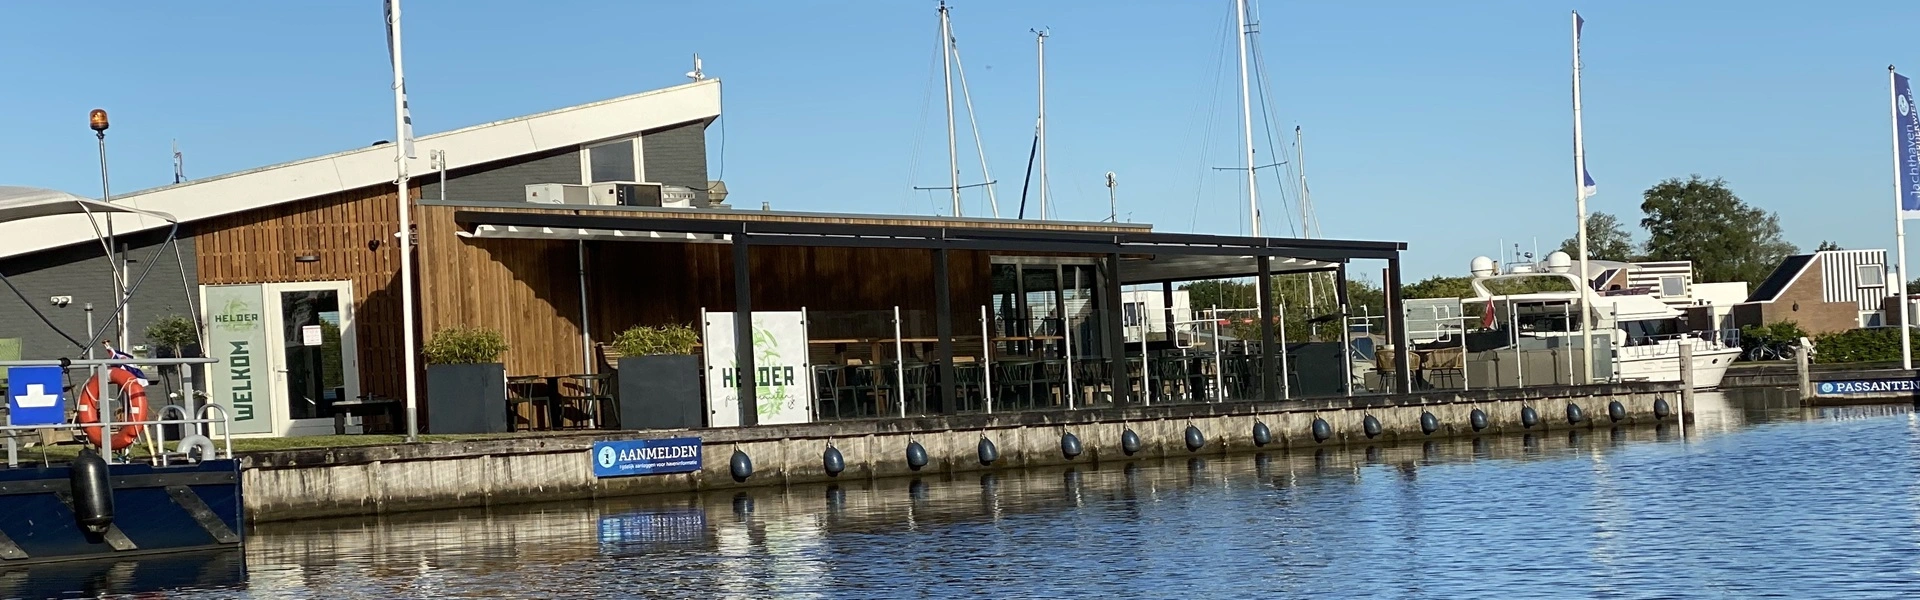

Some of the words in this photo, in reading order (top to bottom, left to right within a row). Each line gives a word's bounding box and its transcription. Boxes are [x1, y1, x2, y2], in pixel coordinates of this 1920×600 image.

[1906, 124, 1920, 197] Jachthaven
[214, 313, 258, 322] HELDER
[229, 340, 254, 421] WELKOM
[722, 366, 794, 388] HEDER
[1836, 380, 1920, 392] PASSANTEN
[618, 445, 698, 461] AANMELDEN
